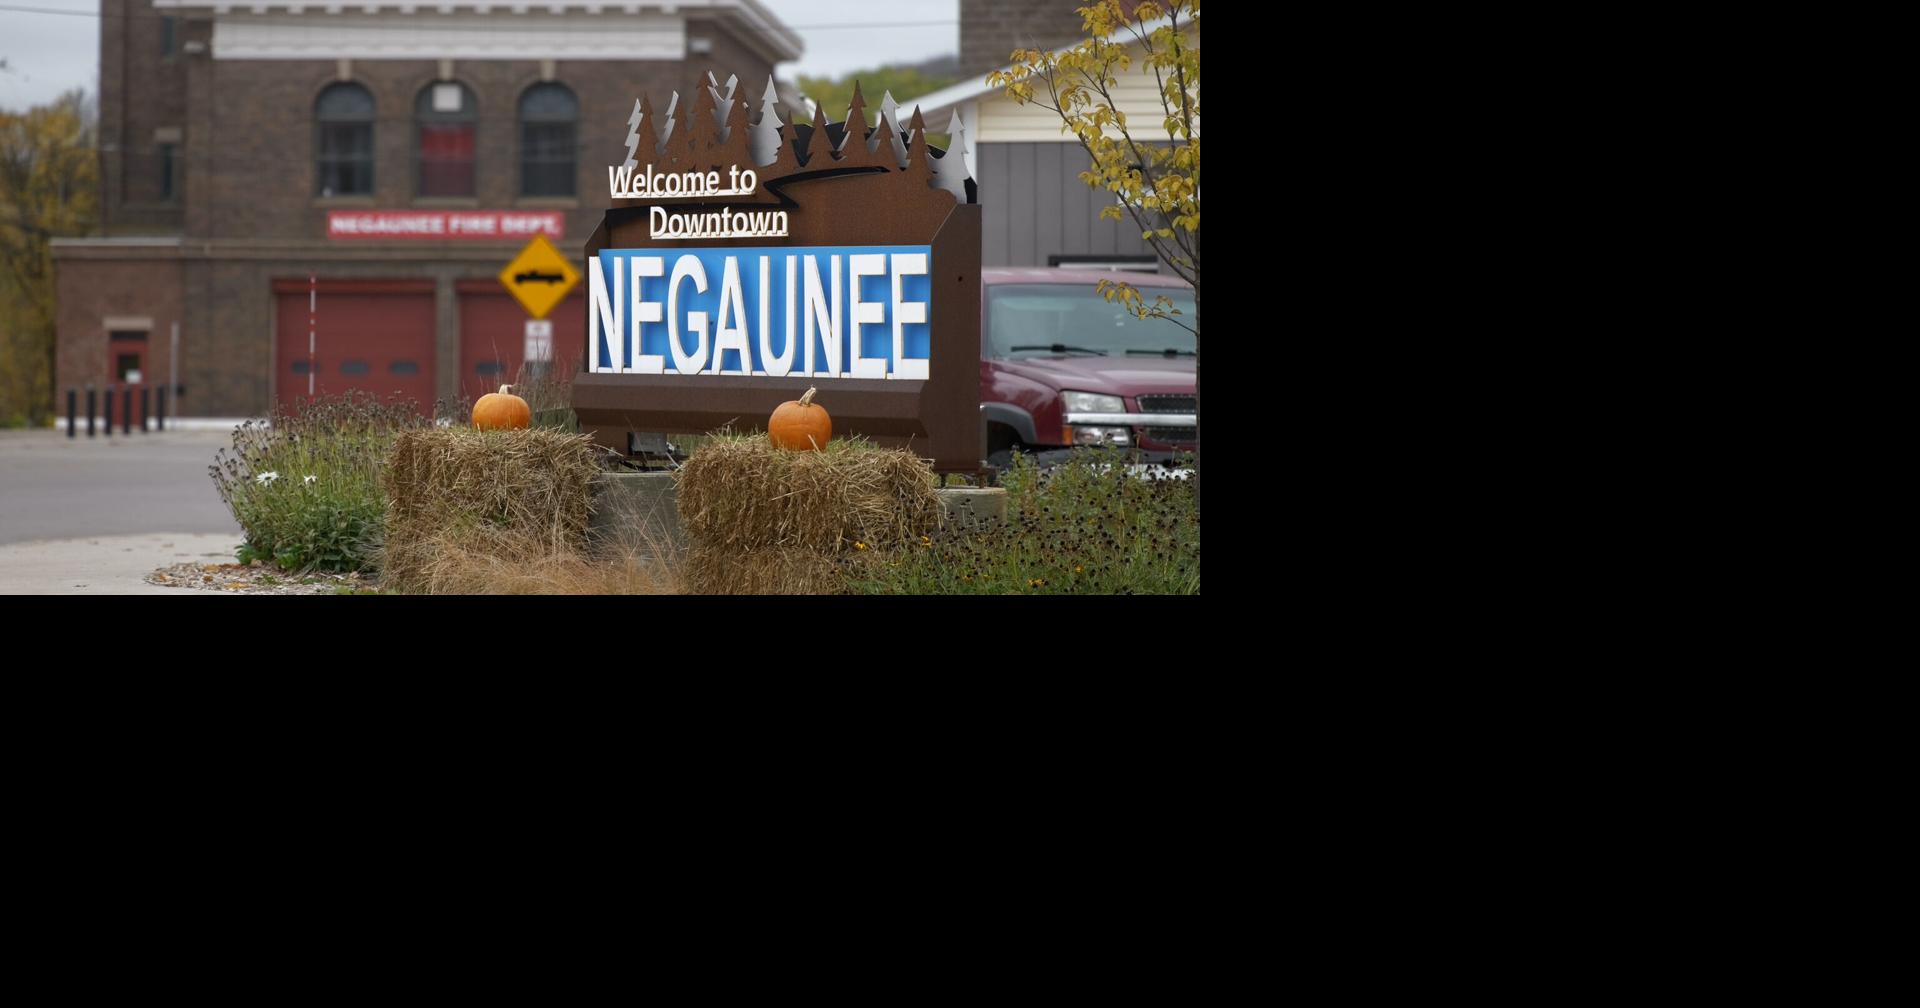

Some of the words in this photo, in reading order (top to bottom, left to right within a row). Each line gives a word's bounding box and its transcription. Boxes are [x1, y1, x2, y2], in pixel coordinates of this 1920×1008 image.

[608, 164, 720, 197] Welcome
[729, 164, 757, 195] to
[330, 215, 444, 235] NEGAUNEE
[449, 215, 497, 235] FIRE
[501, 215, 560, 235] DEPT.
[650, 205, 789, 238] Downtown
[588, 253, 930, 380] NEGAUNEE
